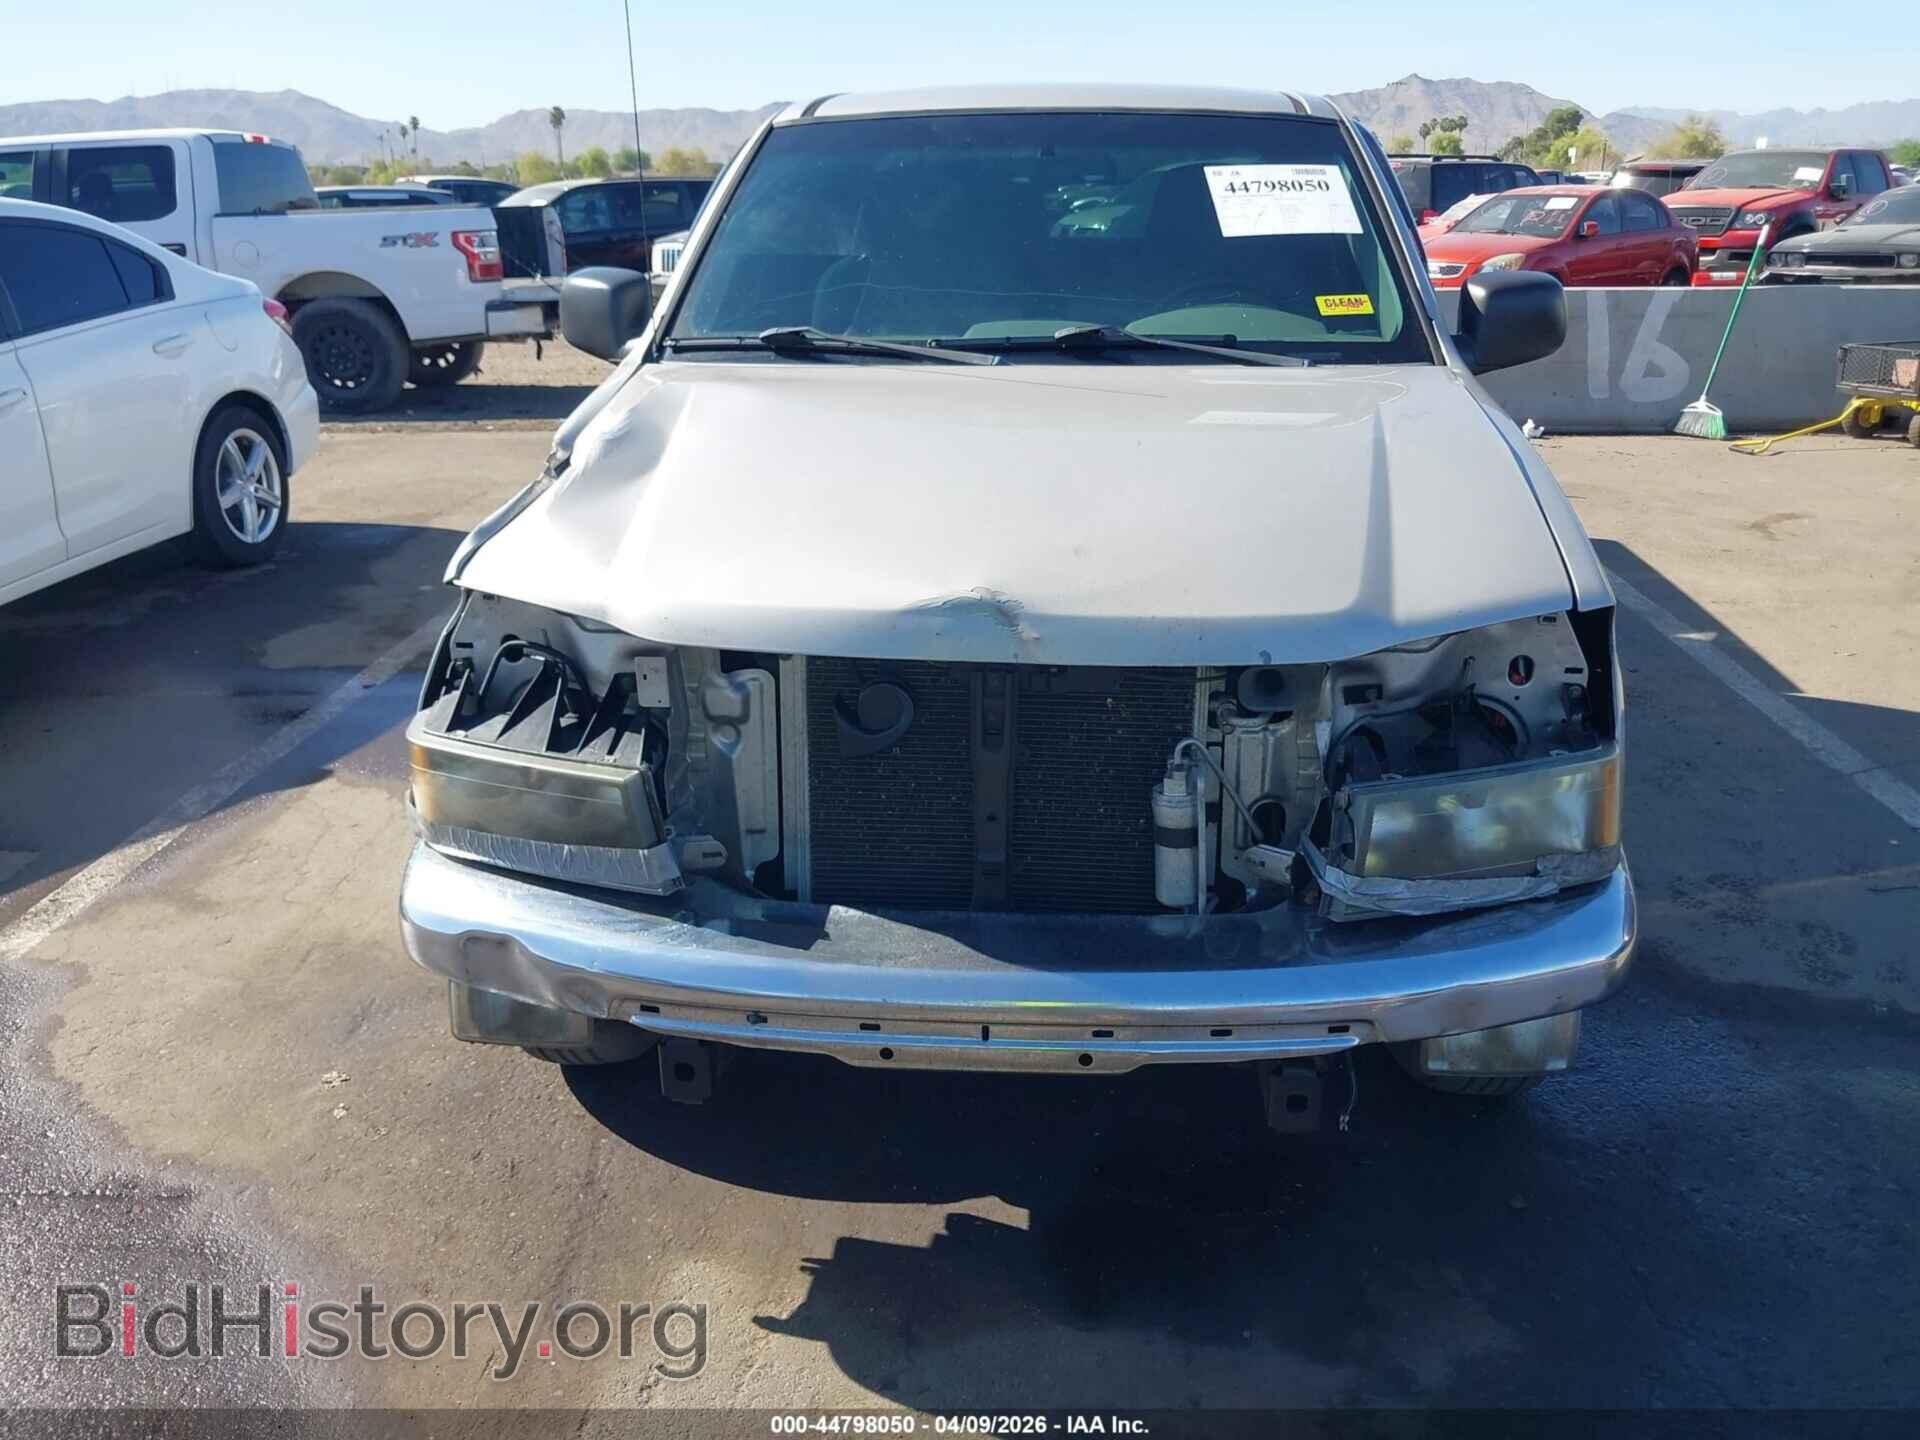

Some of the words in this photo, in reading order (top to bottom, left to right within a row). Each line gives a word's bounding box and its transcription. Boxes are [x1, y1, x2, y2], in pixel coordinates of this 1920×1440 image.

[1224, 179, 1330, 193] 44798050
[1324, 297, 1364, 307] CLEAN
[1586, 291, 1690, 402] 16
